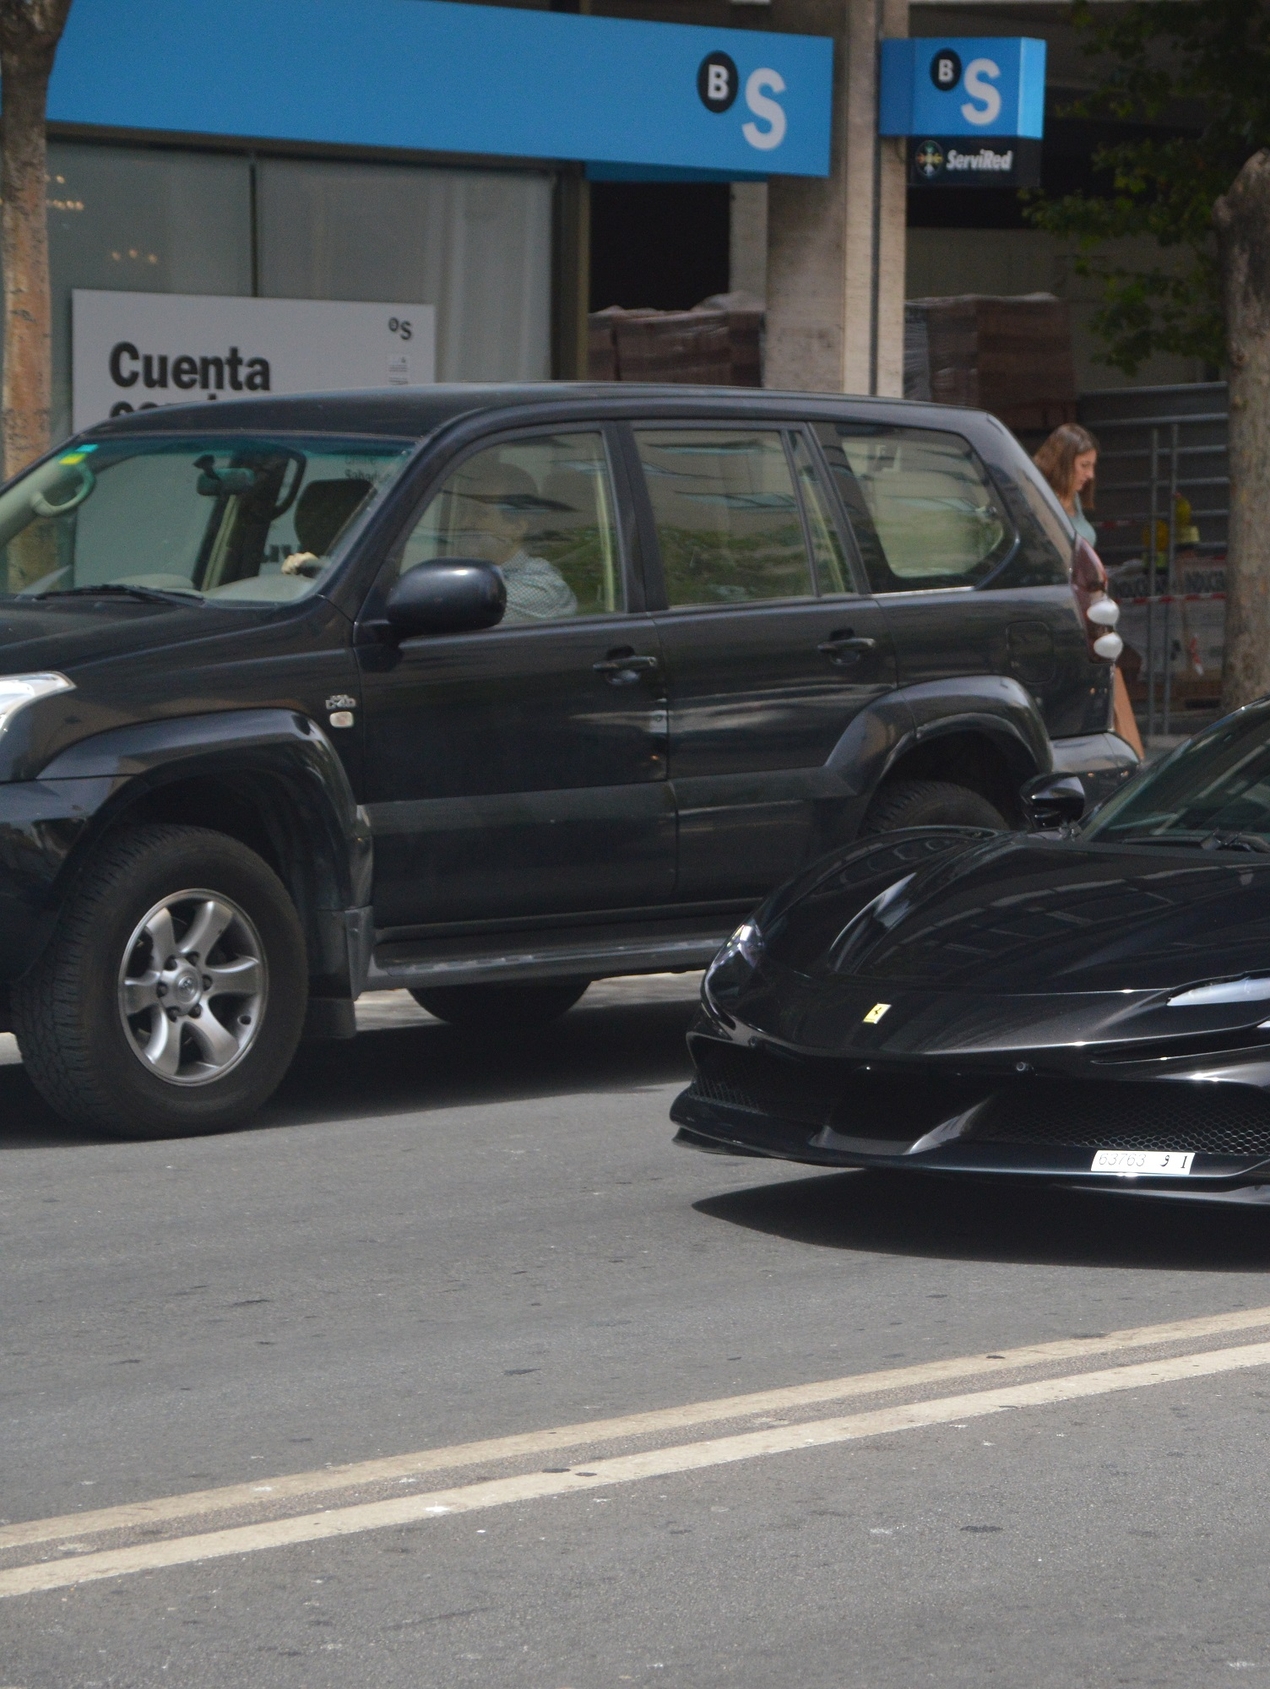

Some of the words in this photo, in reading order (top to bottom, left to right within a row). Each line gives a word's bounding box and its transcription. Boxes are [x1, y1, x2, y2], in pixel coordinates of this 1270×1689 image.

[742, 67, 787, 151] S
[961, 57, 1002, 125] S
[946, 149, 1013, 171] ServiRed
[109, 341, 271, 391] Cuenta
[1099, 1152, 1147, 1167] 63763
